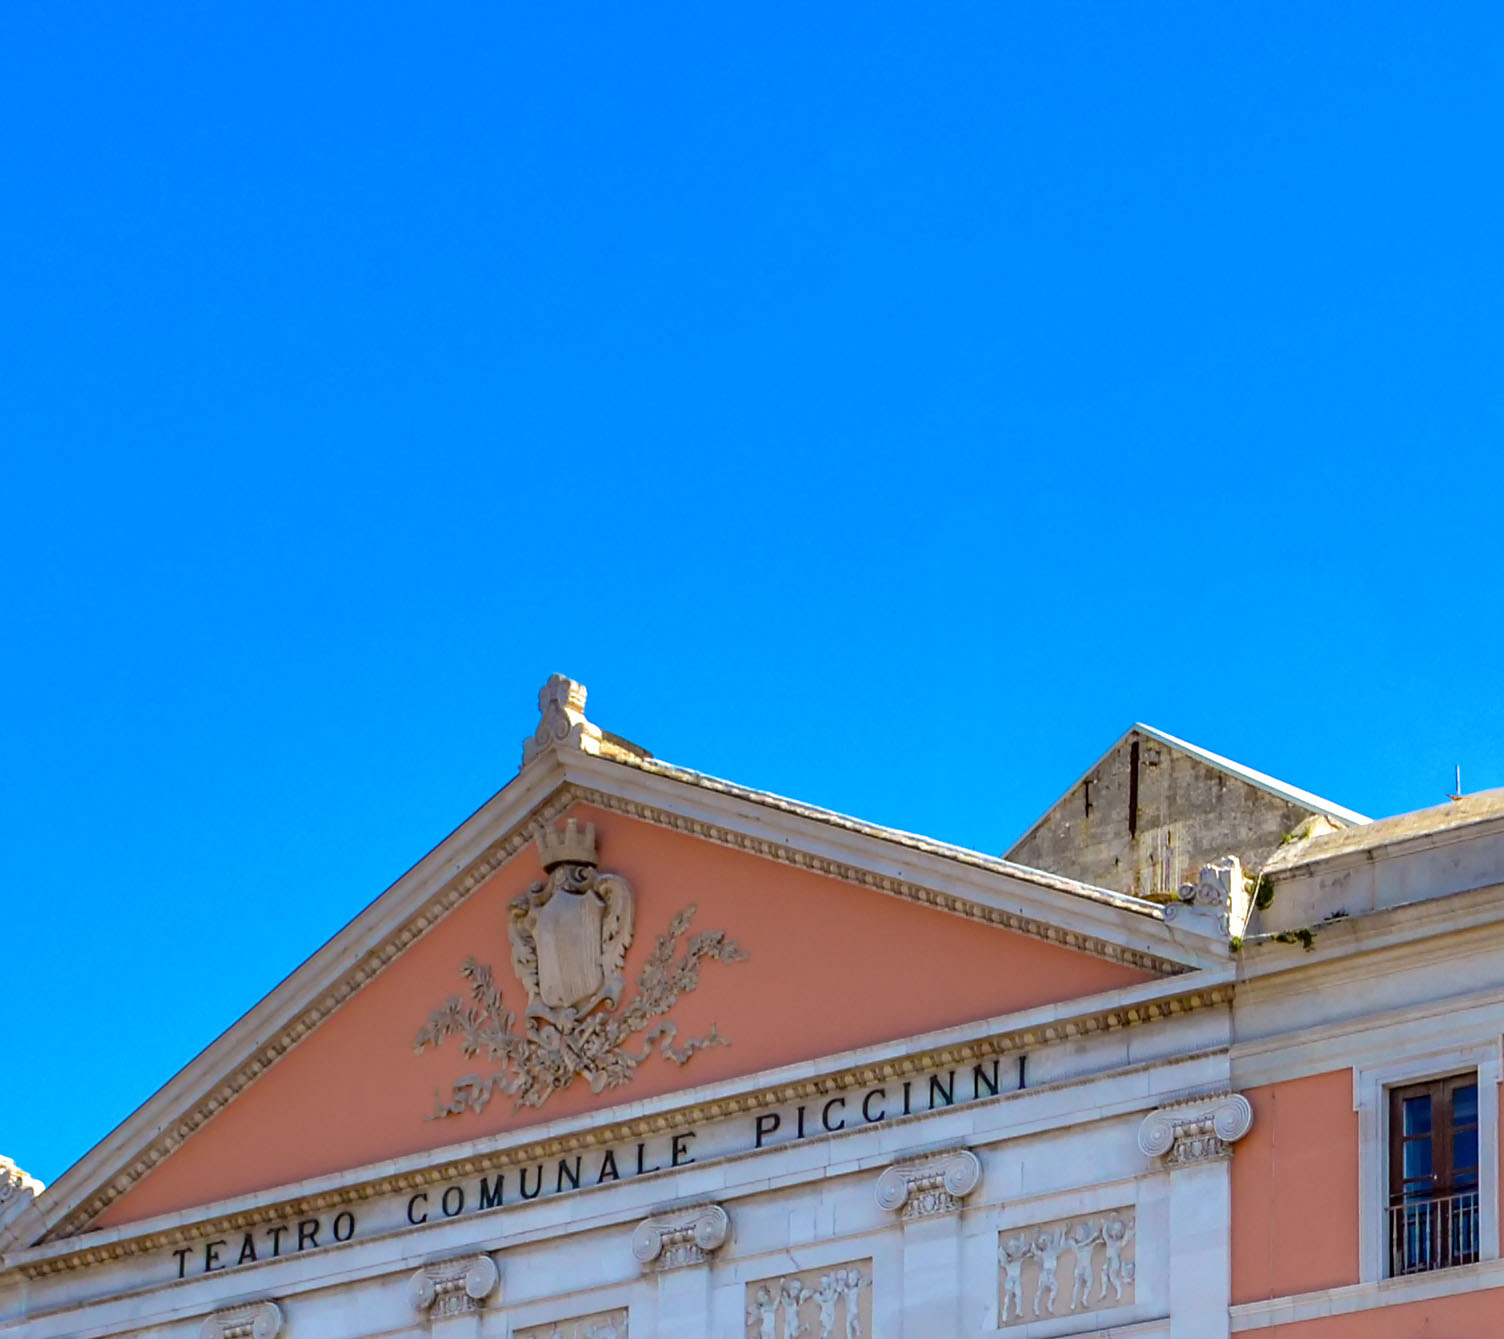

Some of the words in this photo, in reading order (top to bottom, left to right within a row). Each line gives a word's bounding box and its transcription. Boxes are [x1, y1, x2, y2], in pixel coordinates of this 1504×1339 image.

[172, 1211, 356, 1279] TEATRO
[407, 1131, 697, 1226] COMUNALE
[754, 1055, 1027, 1149] PICCINNI
